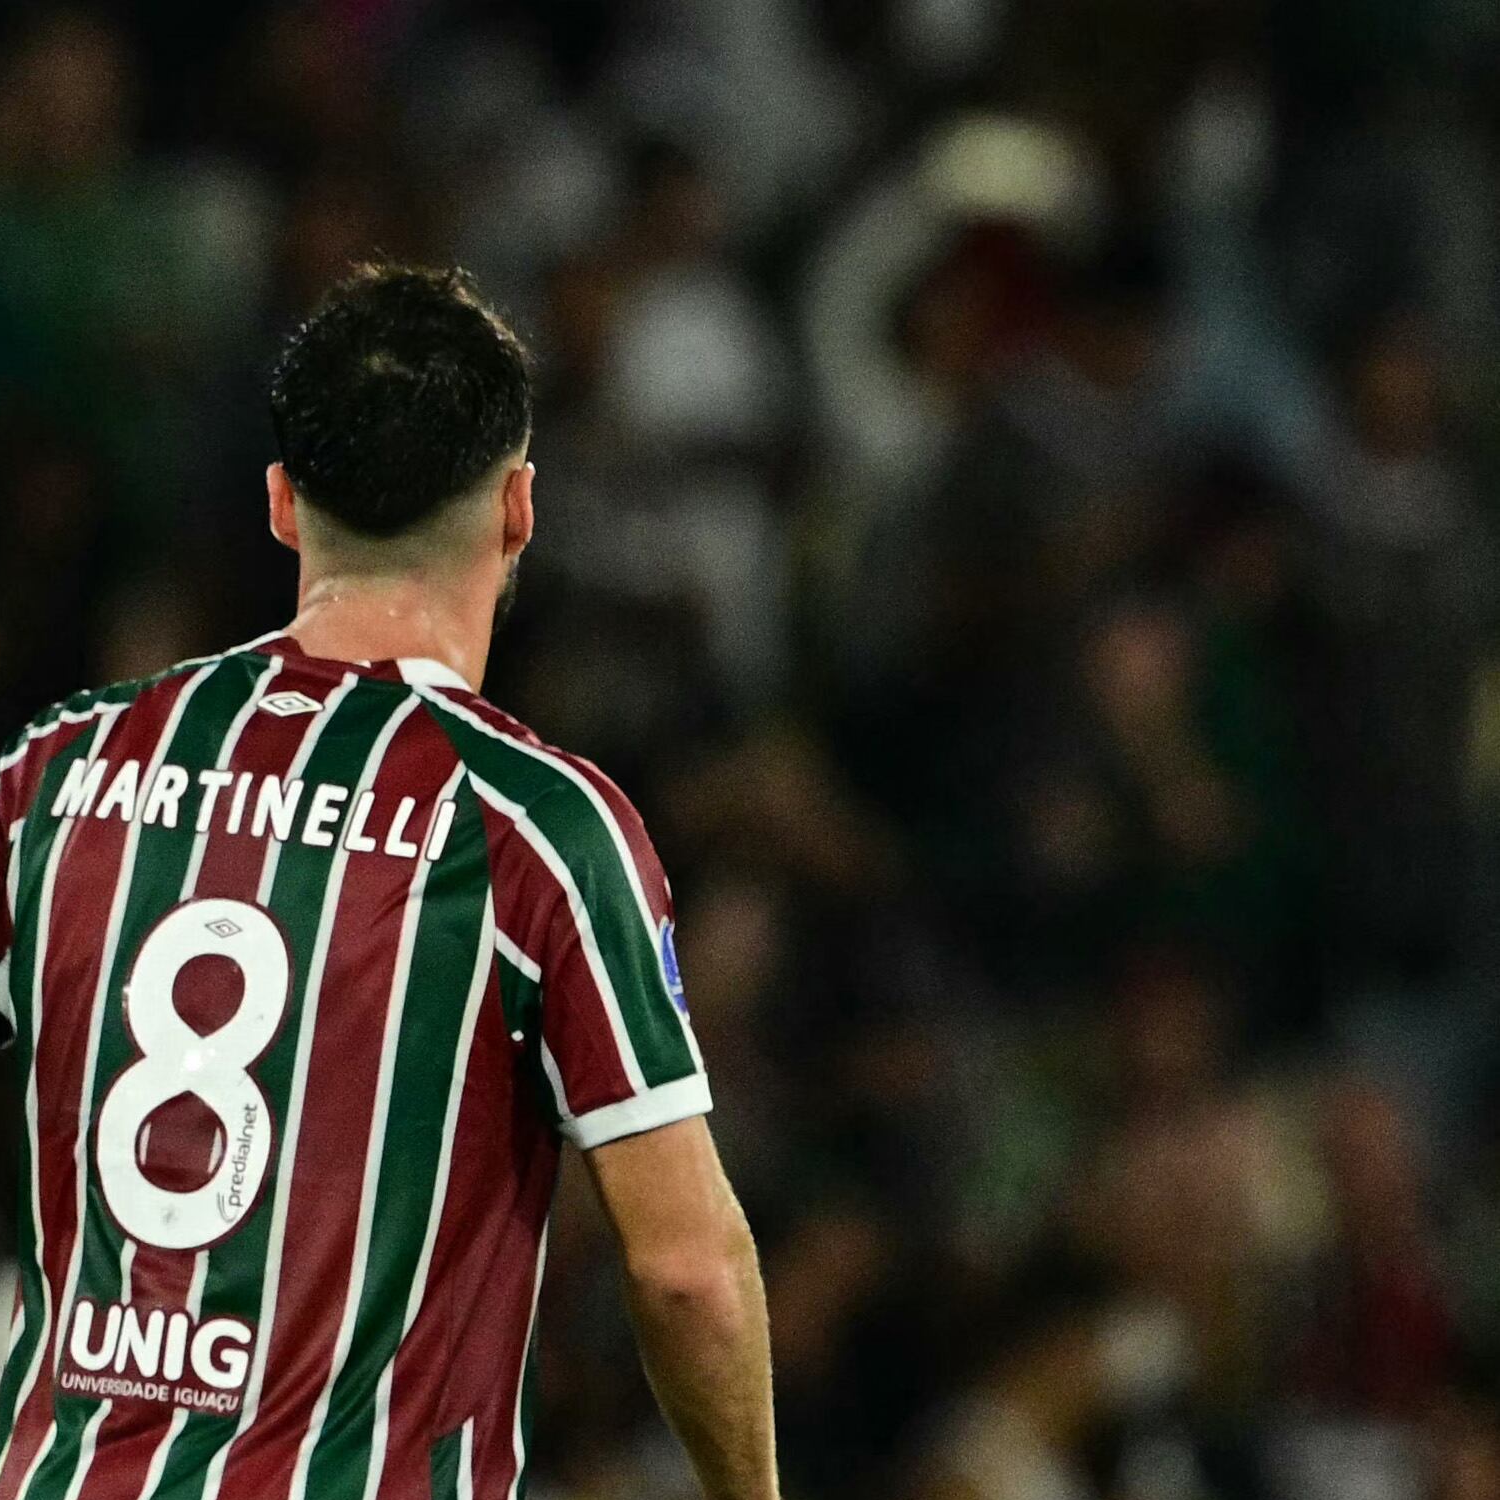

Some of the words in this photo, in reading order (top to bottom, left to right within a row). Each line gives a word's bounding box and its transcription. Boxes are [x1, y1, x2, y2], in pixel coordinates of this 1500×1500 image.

[50, 758, 457, 861] MARTINELLI
[97, 898, 290, 1249] 8
[228, 1103, 258, 1207] predialnet
[61, 1372, 169, 1401] UNIVERSIDADE
[174, 1389, 239, 1411] IGUAÇU
[70, 1300, 251, 1389] UNIG
